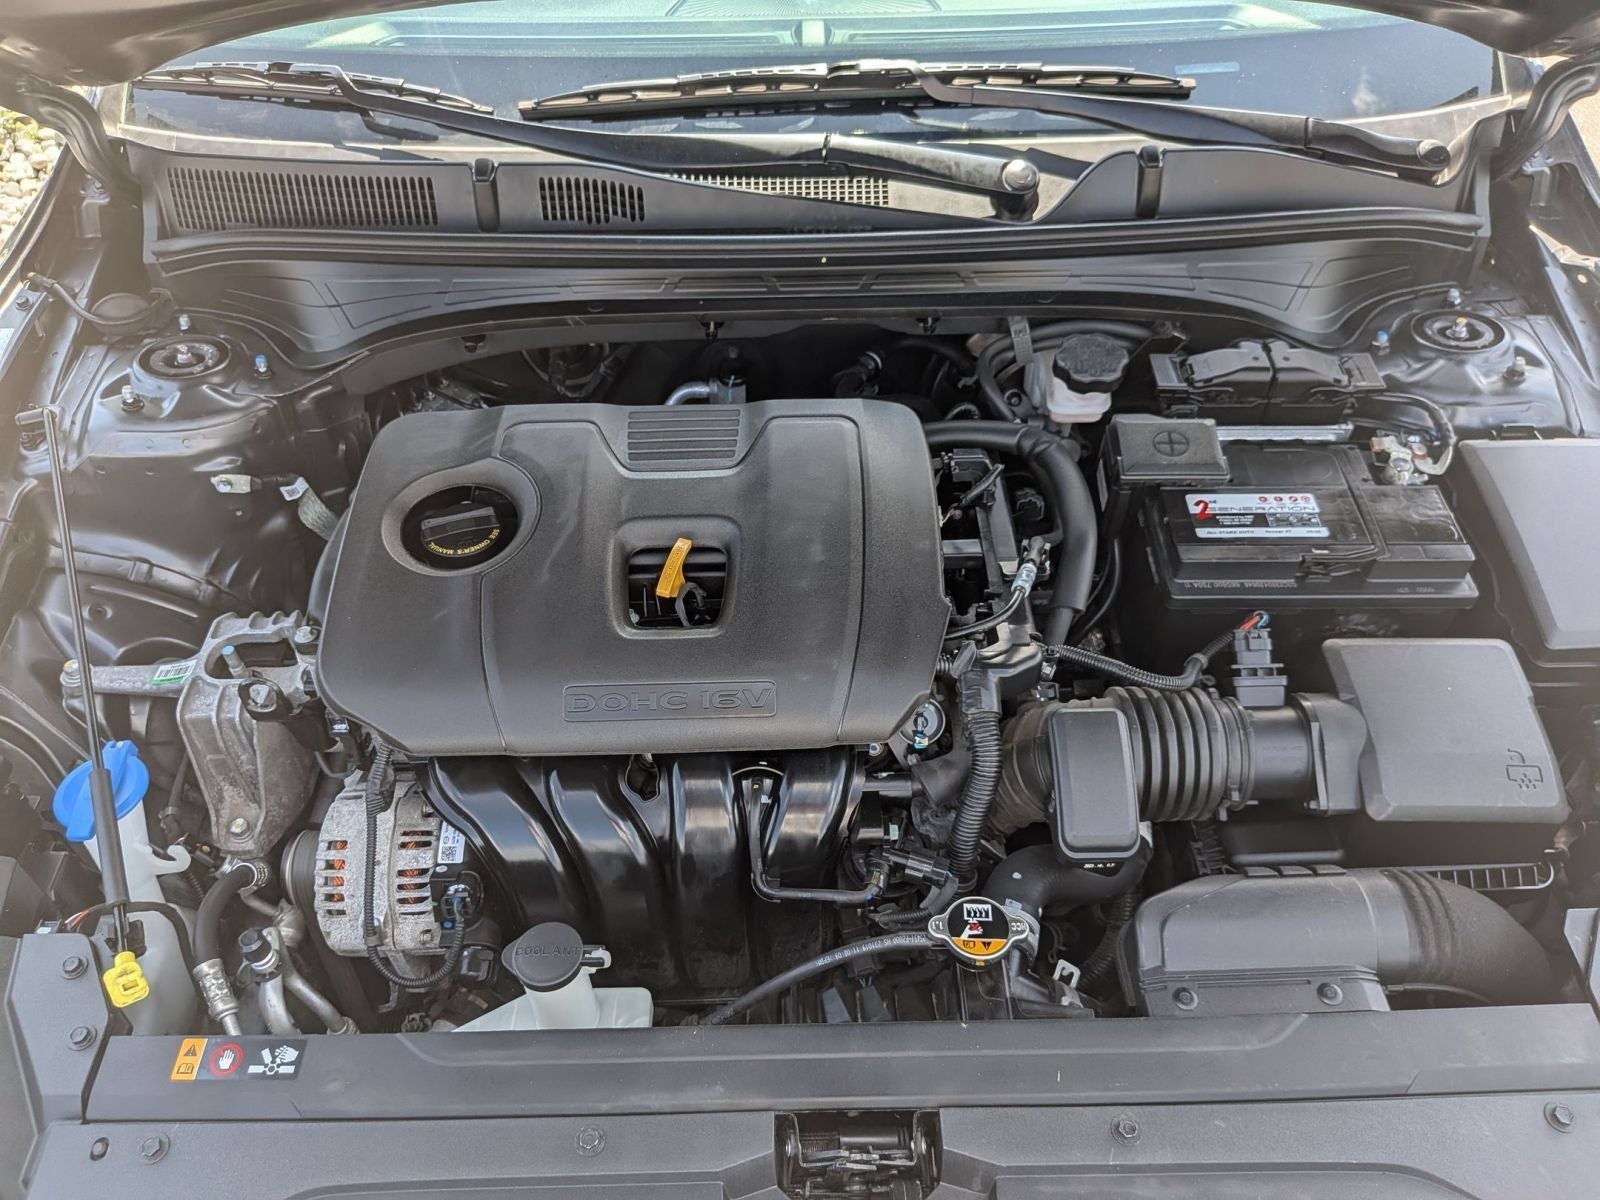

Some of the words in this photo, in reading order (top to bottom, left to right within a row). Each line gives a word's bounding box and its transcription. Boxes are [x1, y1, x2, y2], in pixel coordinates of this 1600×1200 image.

[489, 528, 500, 540] SEE
[428, 542, 454, 555] MANUAL
[457, 539, 490, 555] OWNER'S
[567, 691, 688, 713] DOHC
[700, 688, 773, 710] 16V
[515, 945, 580, 957] COOLANT
